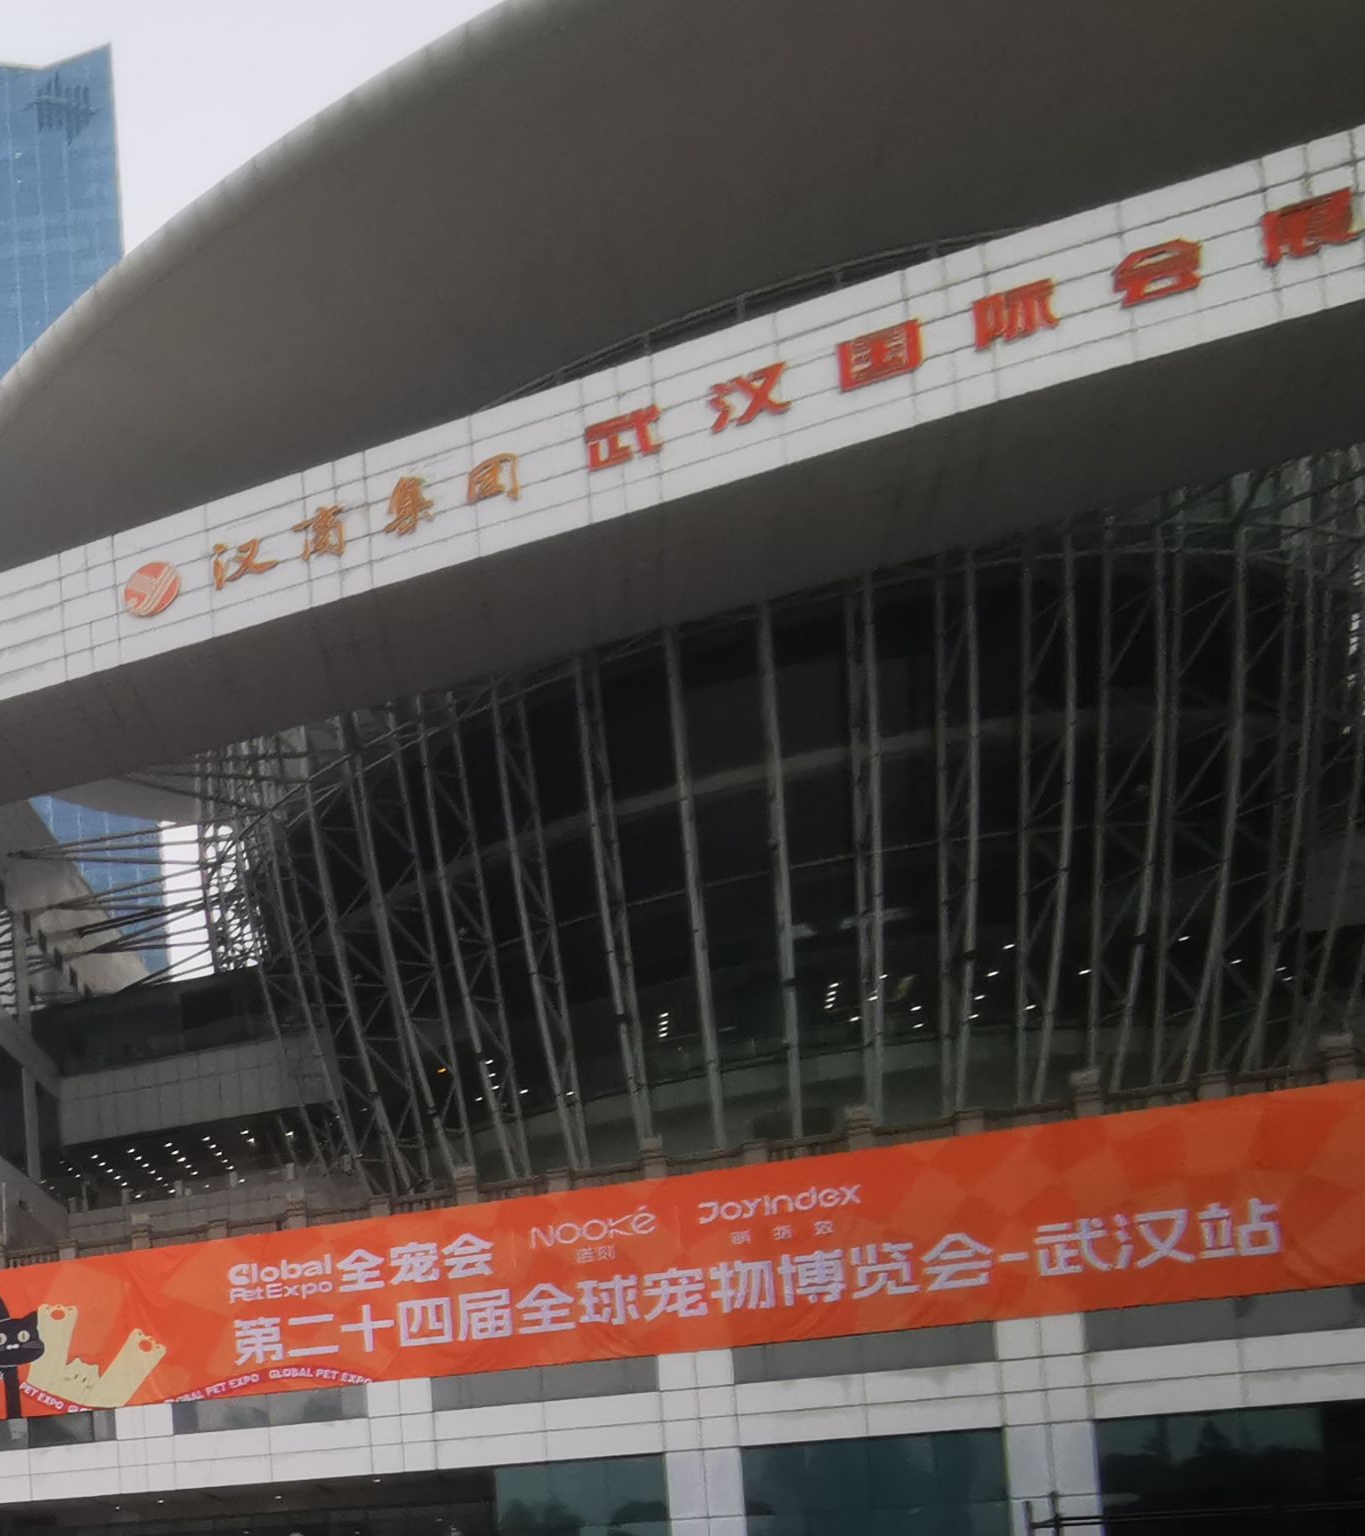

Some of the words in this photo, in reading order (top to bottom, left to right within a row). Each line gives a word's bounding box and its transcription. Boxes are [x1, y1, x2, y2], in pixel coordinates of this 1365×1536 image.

[583, 187, 1355, 471] 武汉国际会展
[228, 1253, 332, 1283] Global
[233, 1198, 1283, 1366] 第二十四届全球宠物博览会-武汉站
[336, 1233, 495, 1293] 全宠会
[228, 1284, 264, 1304] Pet
[266, 1278, 333, 1301] Expo
[268, 1367, 313, 1380] GLOBAL
[316, 1368, 337, 1380] PET
